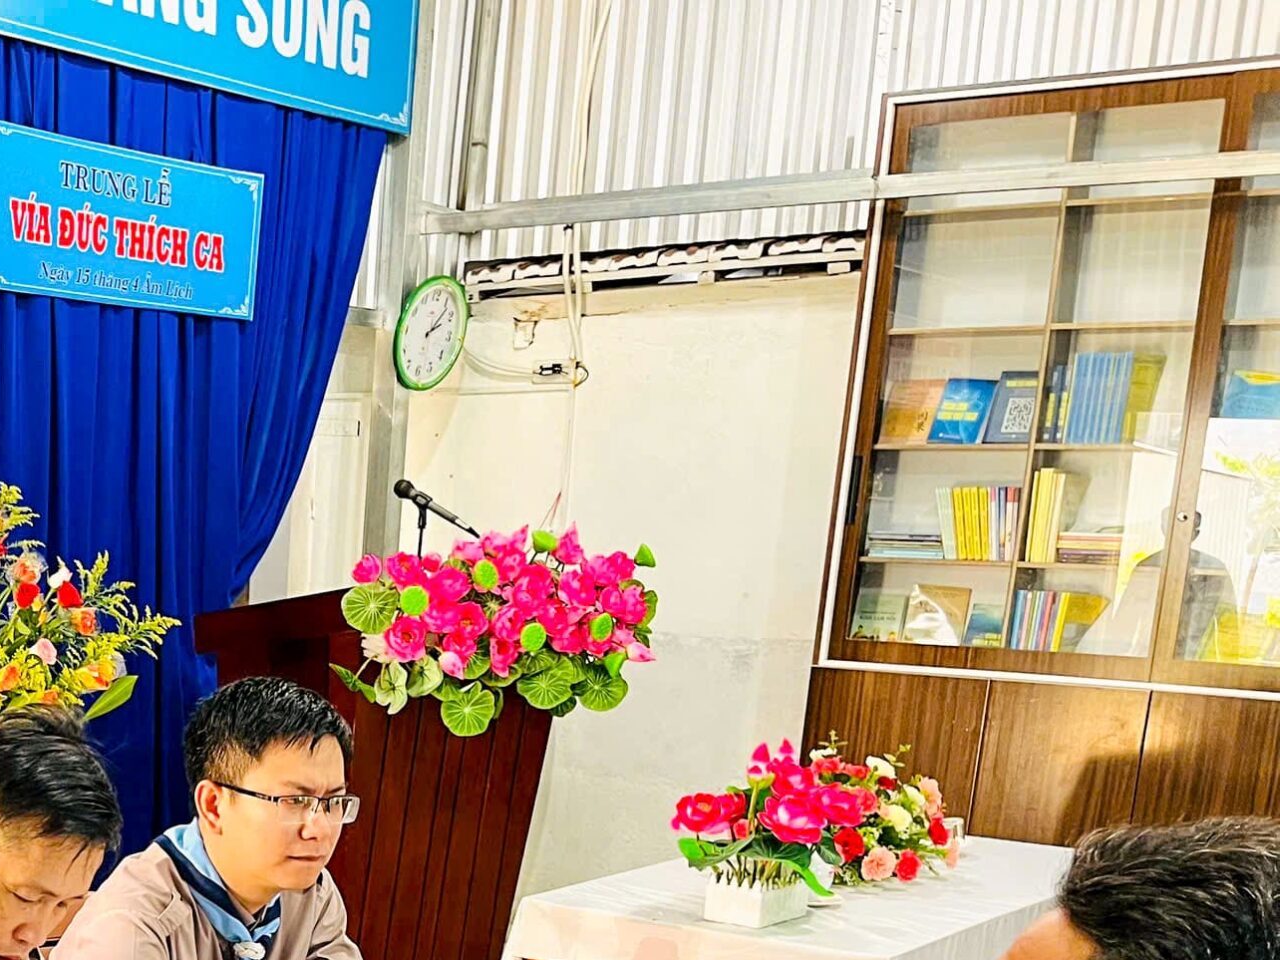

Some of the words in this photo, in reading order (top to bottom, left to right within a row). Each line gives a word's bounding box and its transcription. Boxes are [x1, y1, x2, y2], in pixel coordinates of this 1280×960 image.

[60, 161, 137, 200] TRUNG
[143, 168, 172, 207] LỄ
[10, 193, 52, 244] VÍA
[57, 203, 108, 253] ĐỨC
[114, 216, 188, 266] THÍCH
[194, 232, 225, 271] CA
[38, 261, 71, 284] Ngày
[75, 268, 90, 284] 15
[93, 270, 129, 291] tháng
[132, 277, 140, 291] 4
